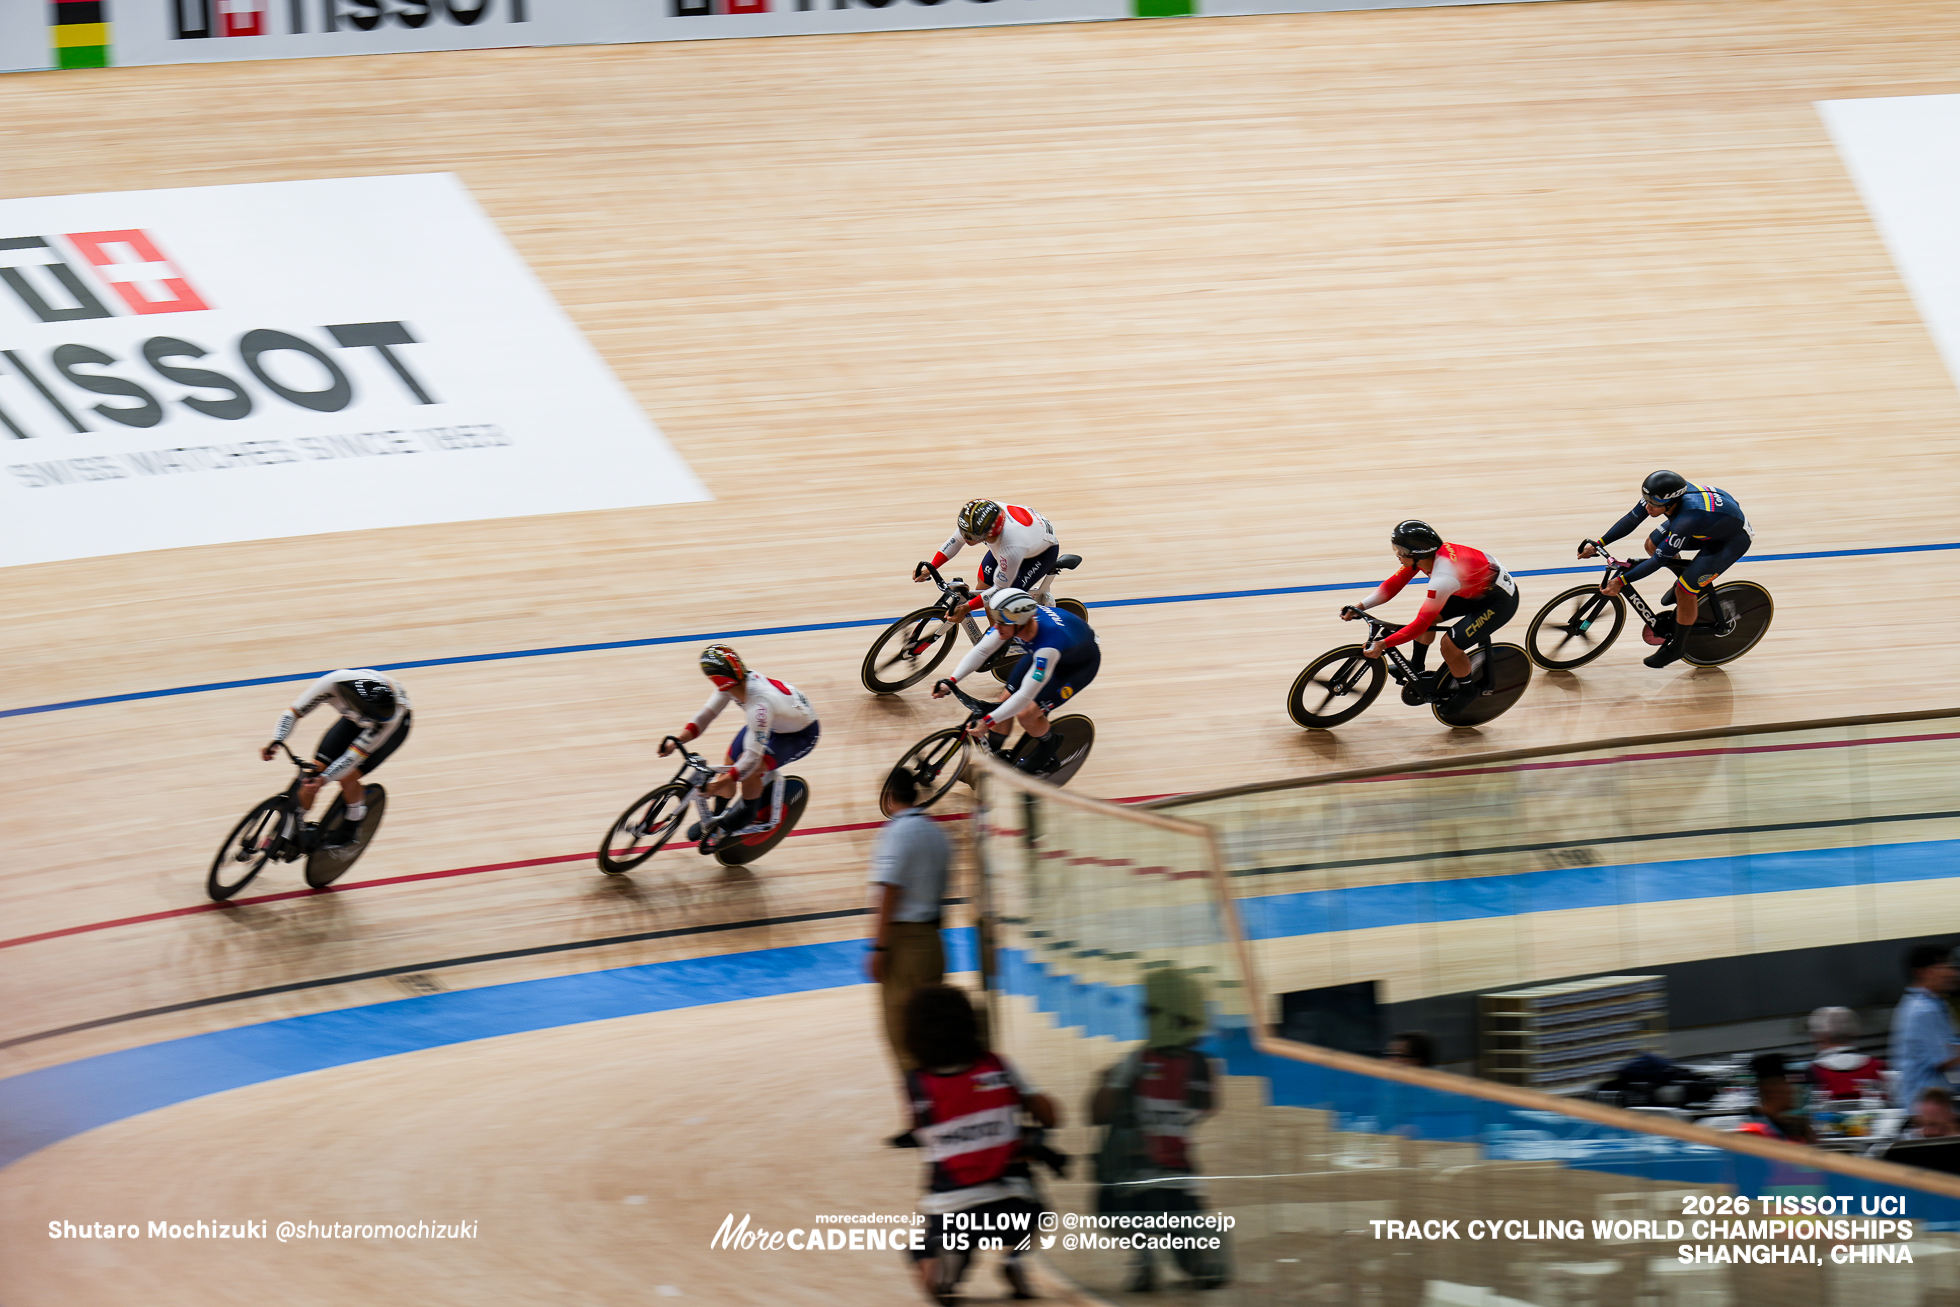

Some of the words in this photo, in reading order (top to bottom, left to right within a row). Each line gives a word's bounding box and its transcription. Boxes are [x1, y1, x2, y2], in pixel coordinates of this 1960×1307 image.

[1668, 533, 1687, 550] Col
[1021, 560, 1042, 588] JAPAN
[1465, 608, 1496, 638] CHINA
[1629, 593, 1657, 628] KOGA
[1391, 651, 1419, 682] PARDUS
